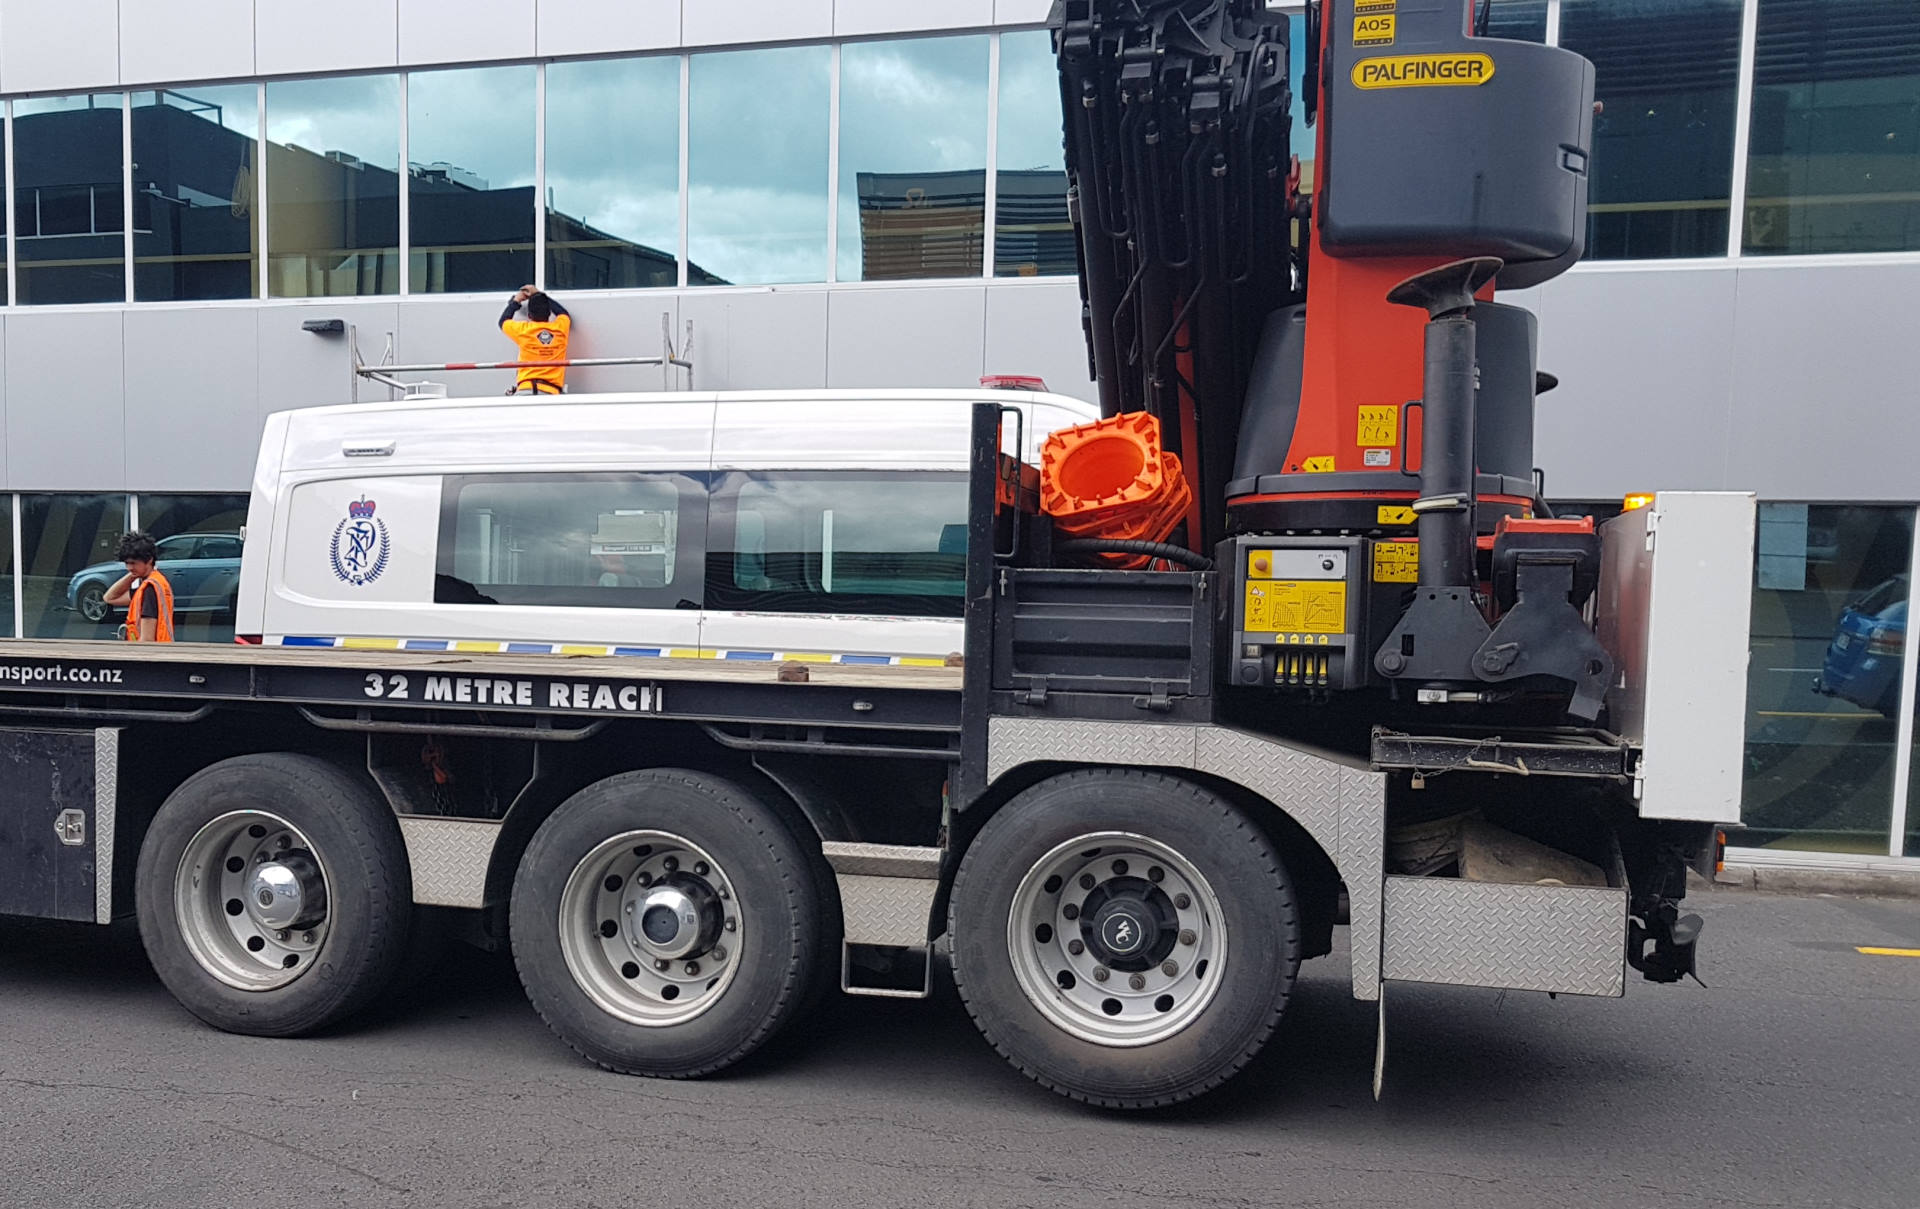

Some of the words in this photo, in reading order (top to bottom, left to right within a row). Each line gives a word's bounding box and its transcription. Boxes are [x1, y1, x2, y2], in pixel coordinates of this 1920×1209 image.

[1357, 18, 1391, 32] AOS
[1362, 60, 1484, 82] PALFINGER
[364, 673, 409, 699] 32
[423, 676, 533, 706] METRE
[549, 682, 663, 712] REACH
